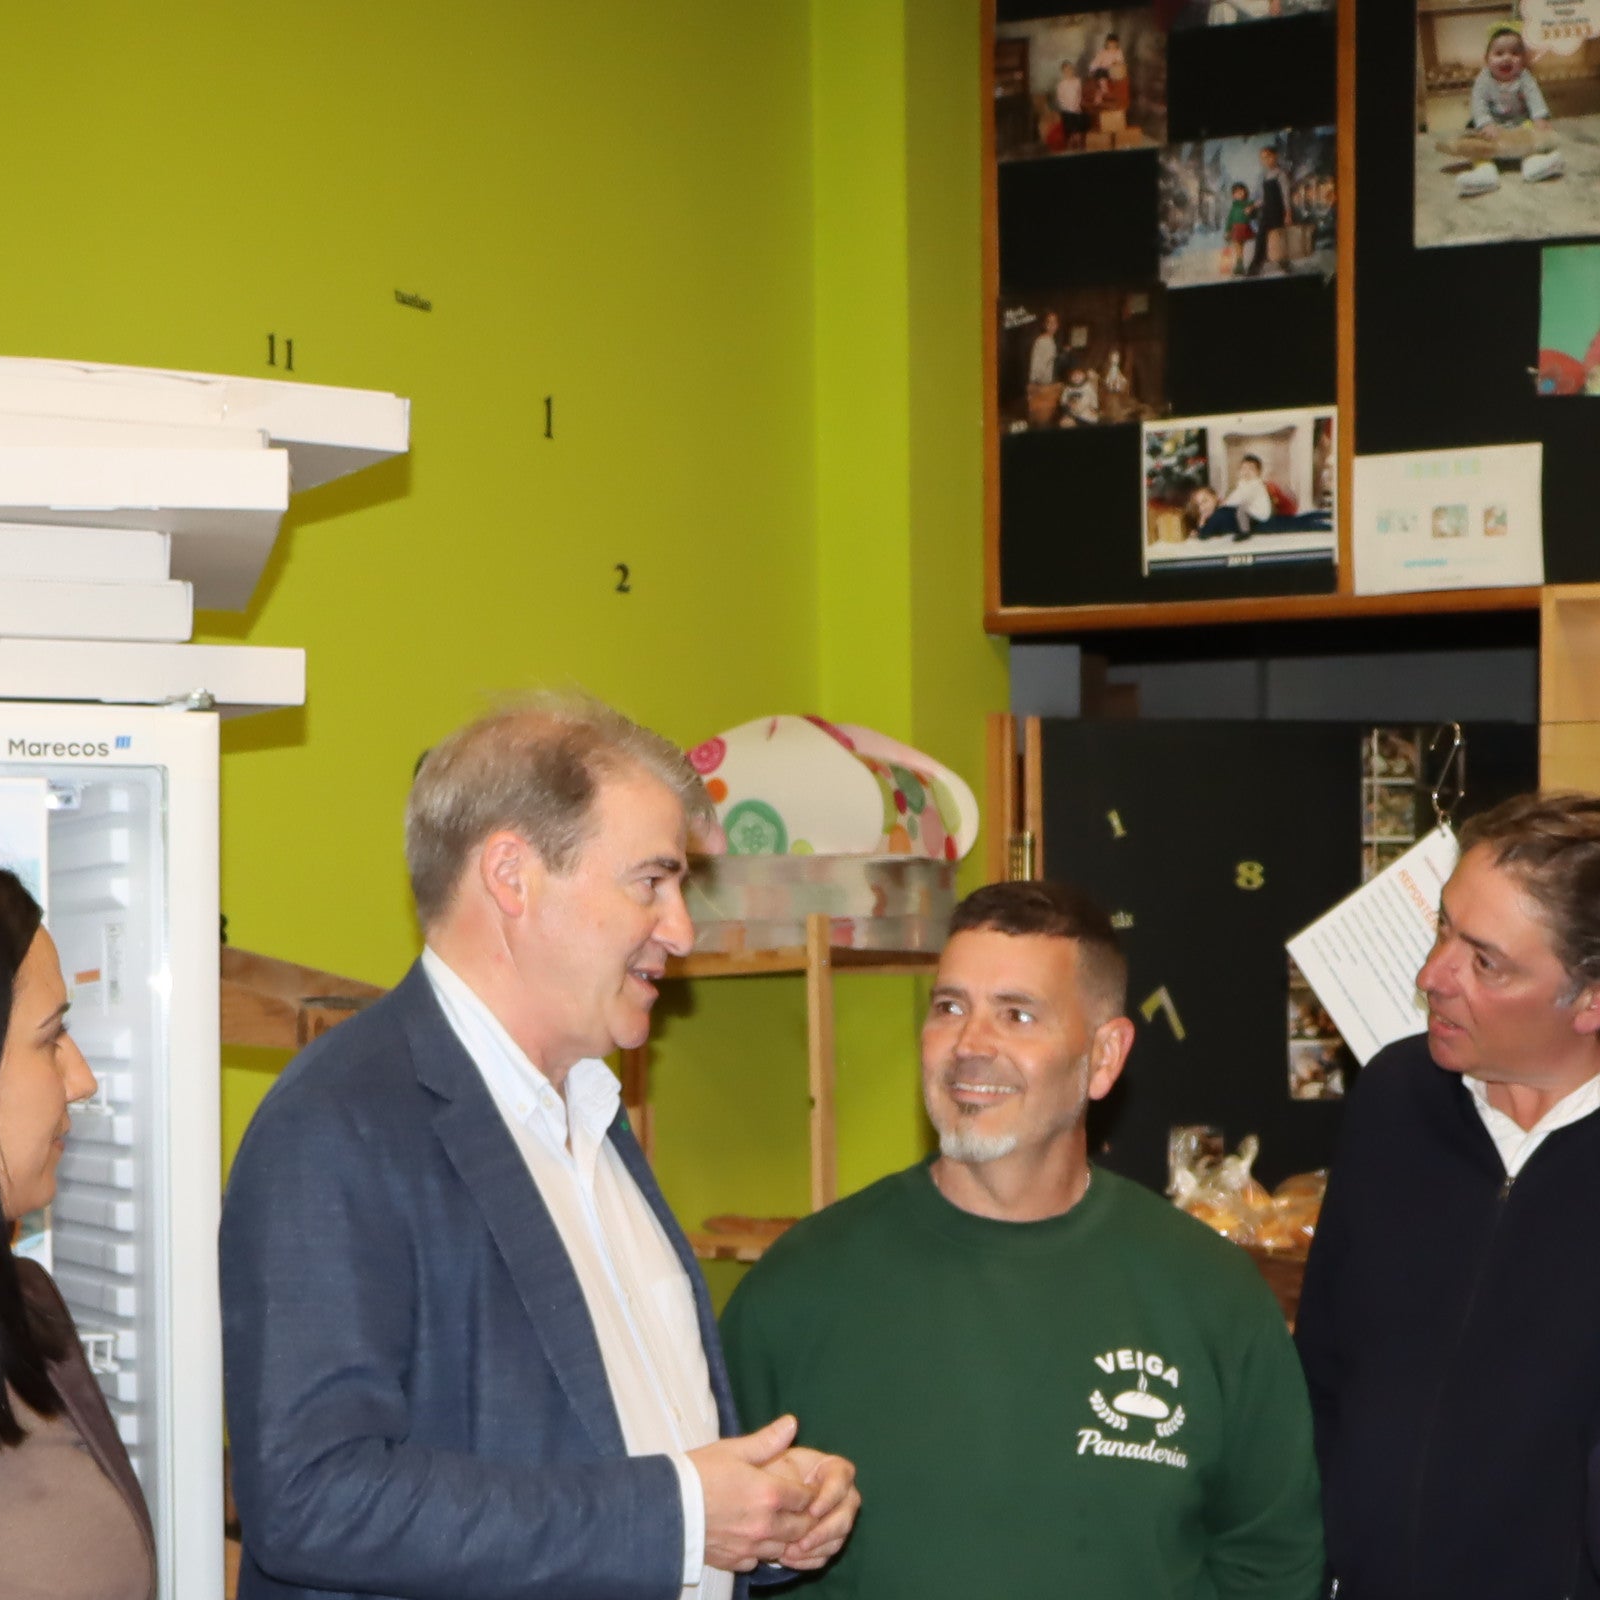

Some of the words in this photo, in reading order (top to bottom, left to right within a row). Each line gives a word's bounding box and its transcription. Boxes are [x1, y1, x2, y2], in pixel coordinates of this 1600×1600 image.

[614, 562, 632, 594] 2
[7, 738, 110, 758] Marecos
[1234, 861, 1266, 891] 8
[1093, 1348, 1179, 1389] VEIGA
